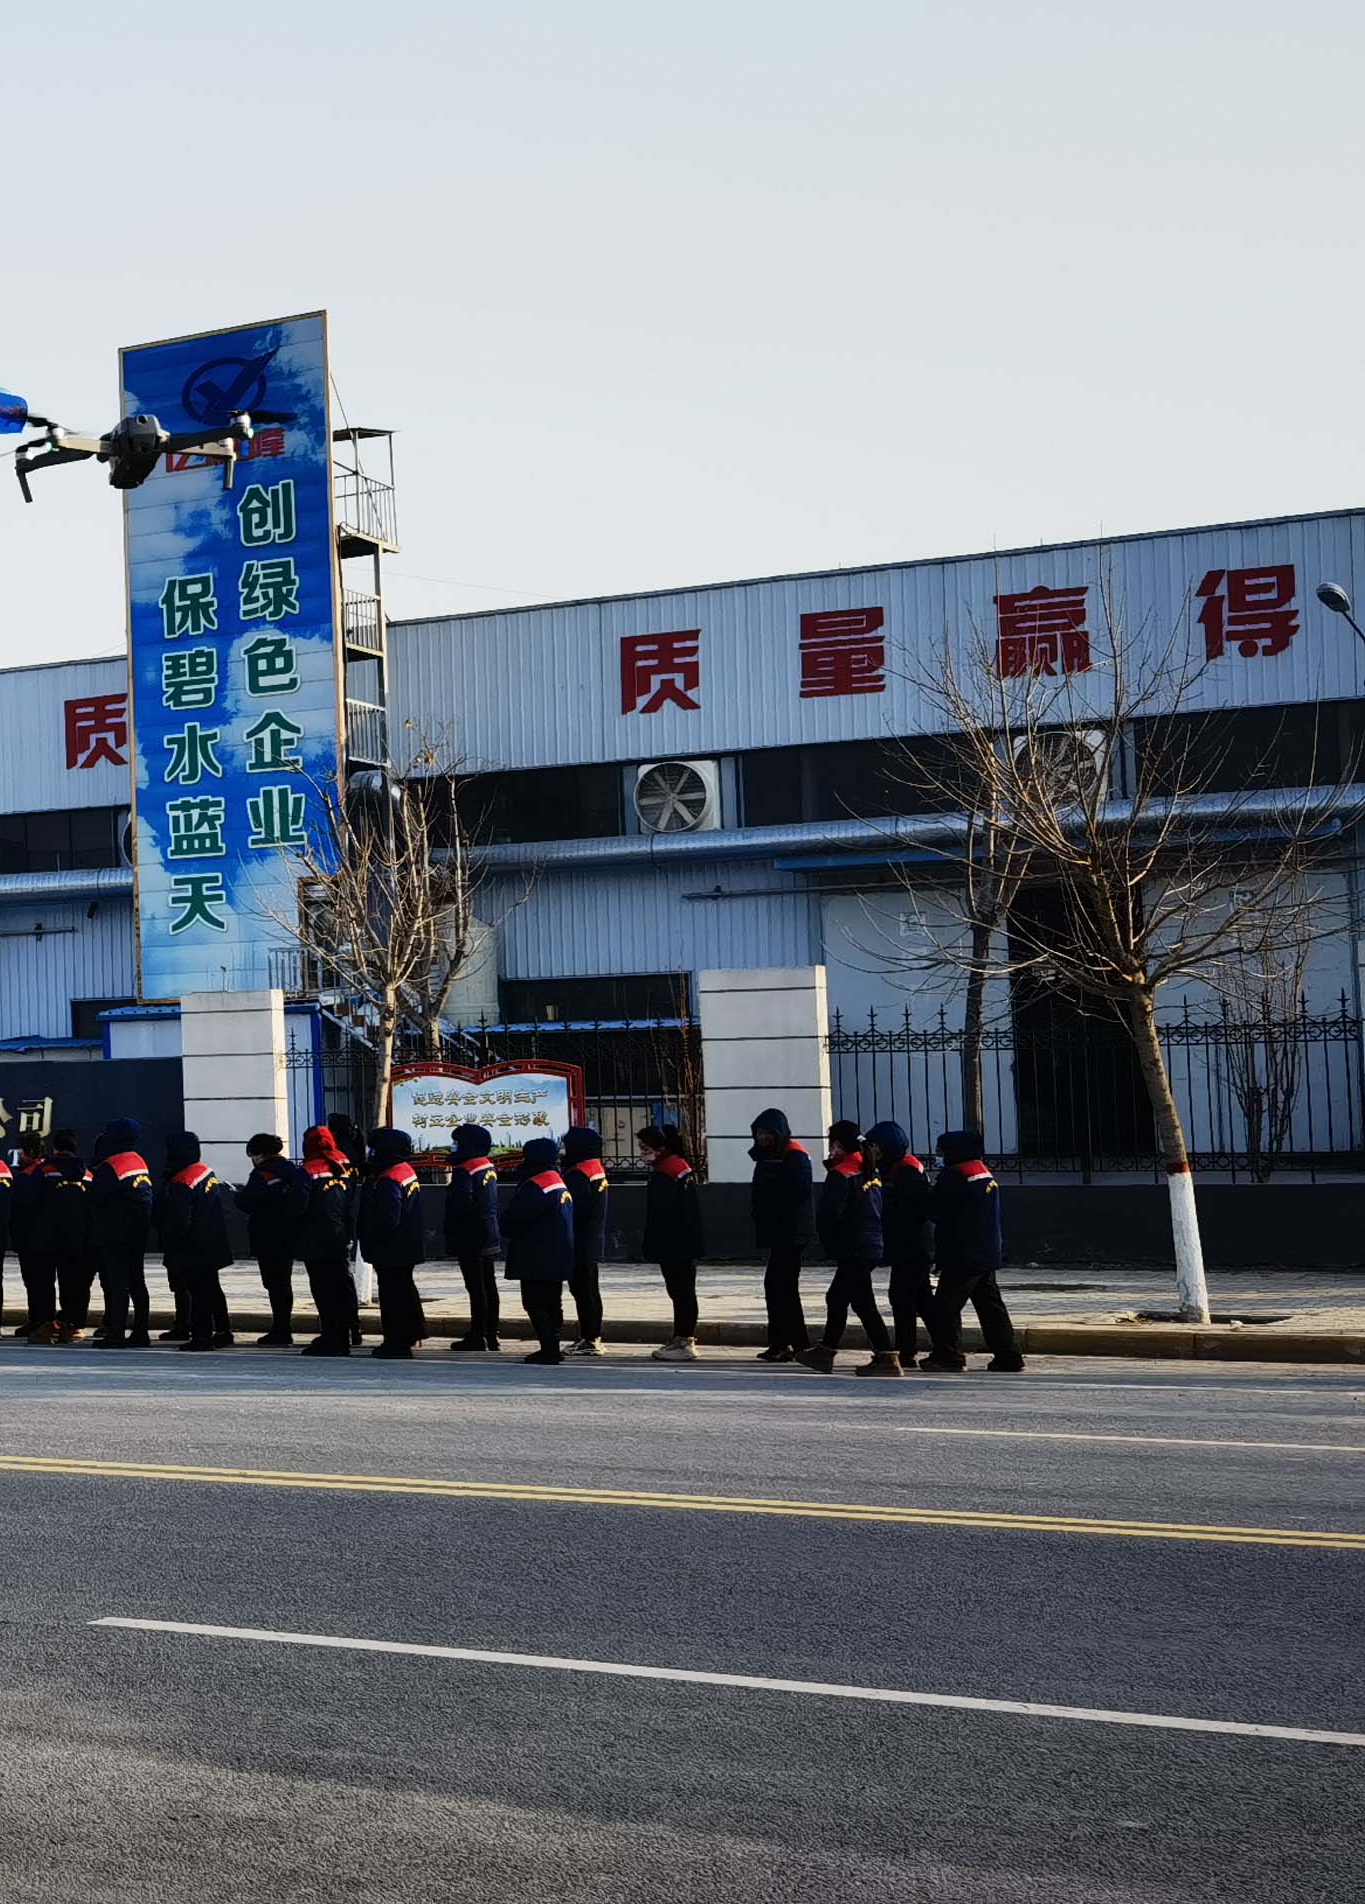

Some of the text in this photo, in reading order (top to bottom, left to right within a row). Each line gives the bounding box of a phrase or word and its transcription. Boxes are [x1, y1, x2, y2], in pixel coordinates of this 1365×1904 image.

[158, 572, 228, 936] 保碧水蓝天
[237, 478, 307, 849] 创绿色企业
[619, 564, 1301, 716] 质量赢得
